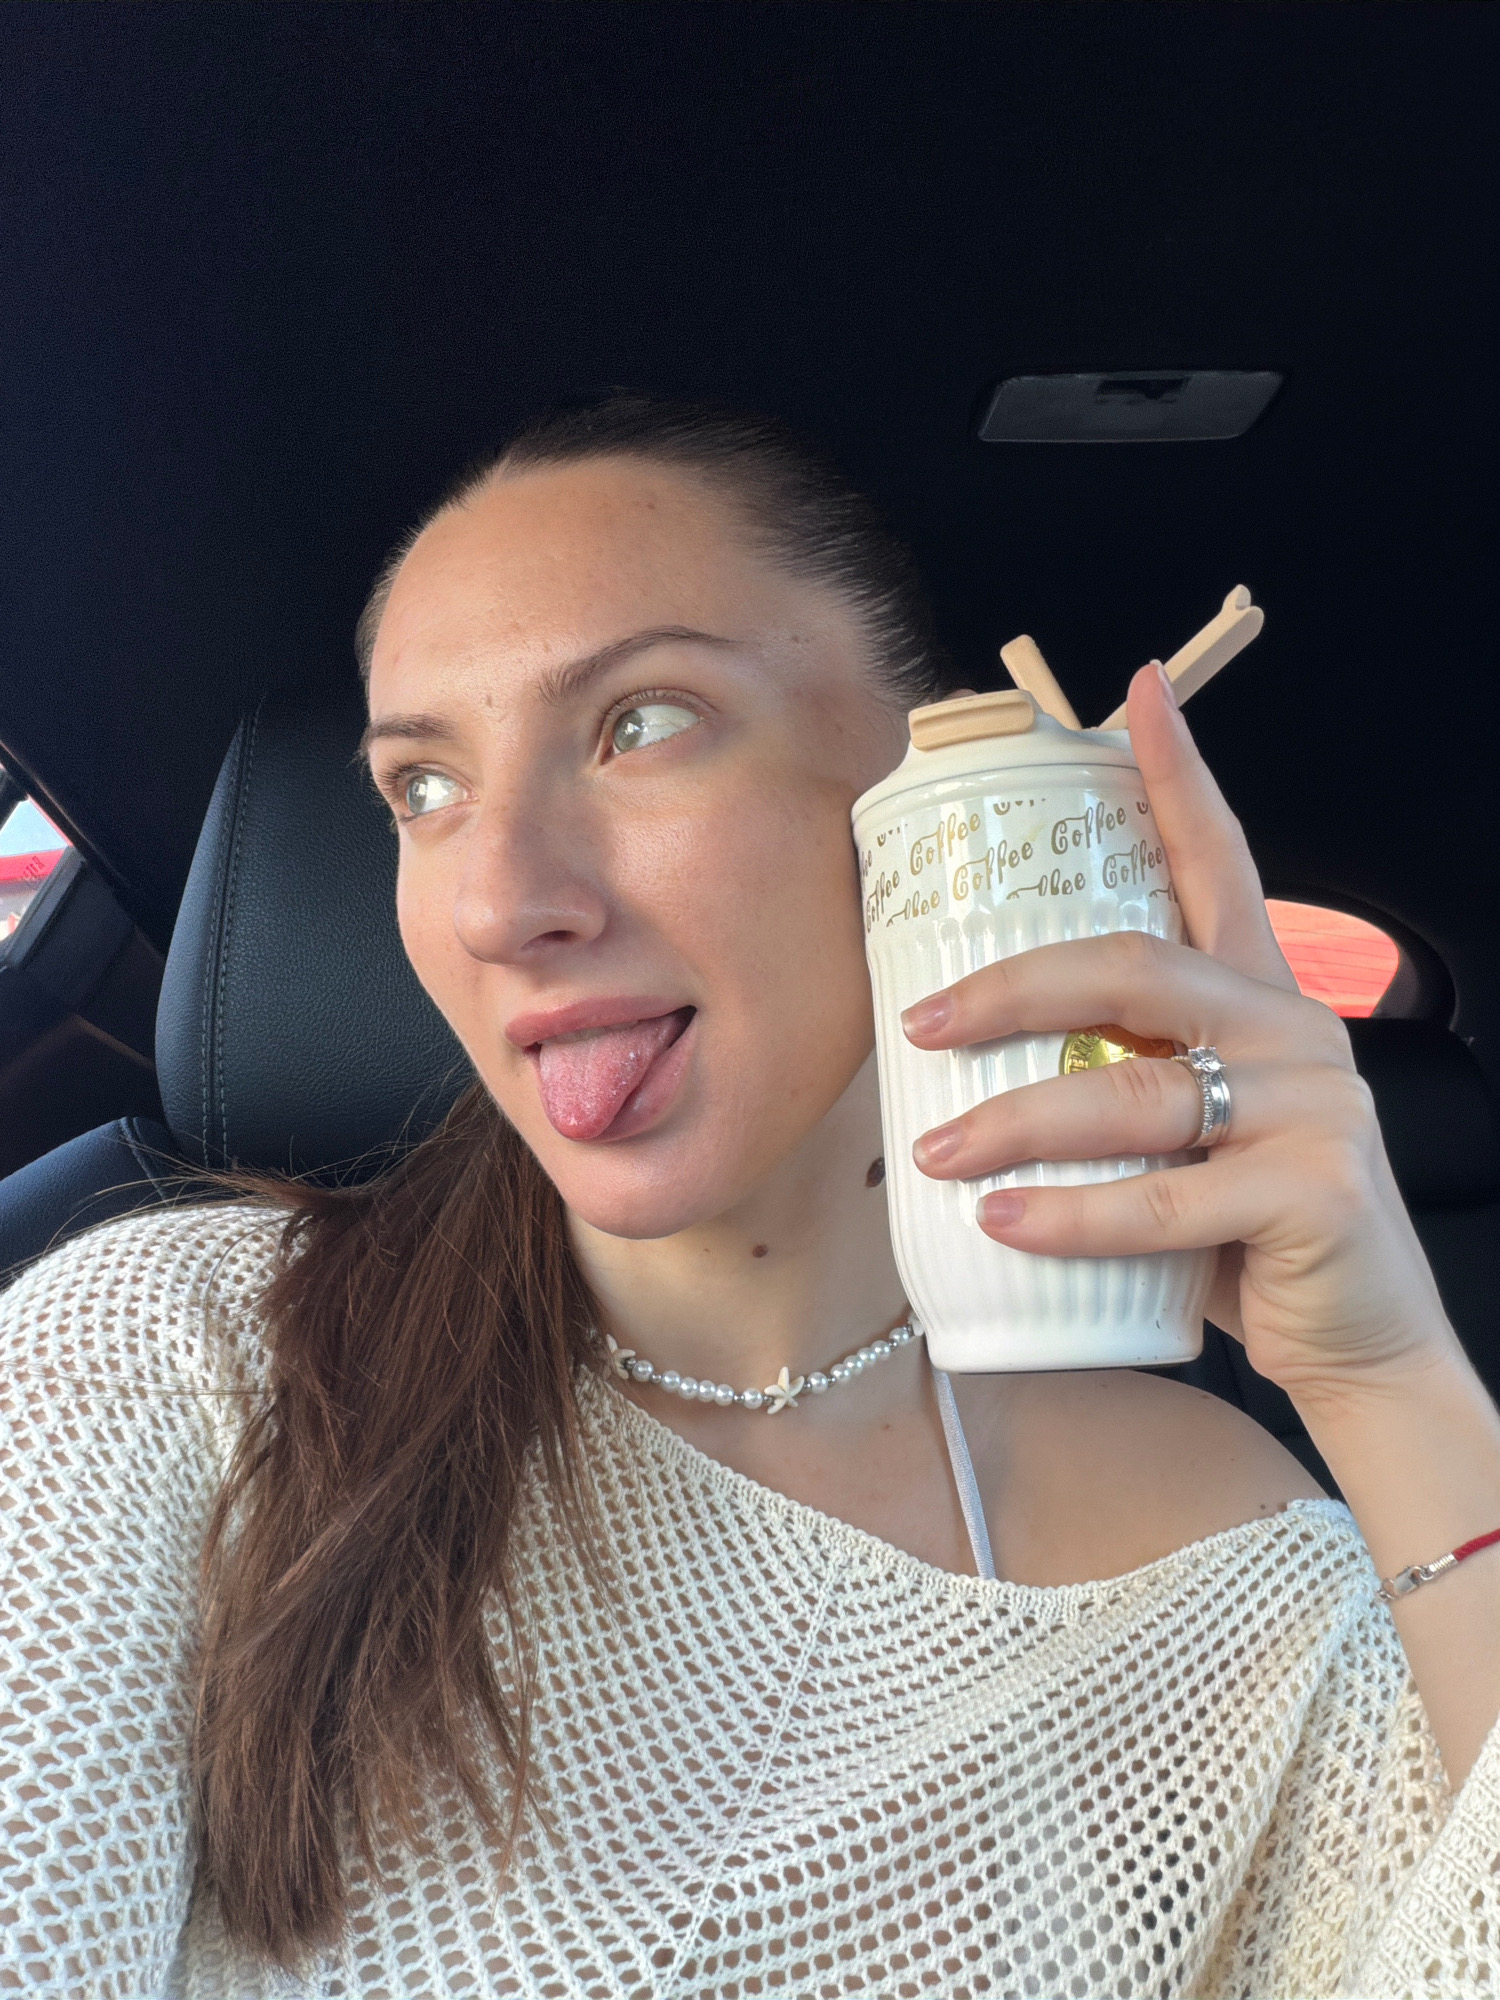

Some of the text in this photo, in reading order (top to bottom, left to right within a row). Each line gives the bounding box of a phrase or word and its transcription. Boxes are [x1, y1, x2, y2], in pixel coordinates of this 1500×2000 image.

[910, 812, 981, 876] Coffee
[1051, 801, 1126, 855] Coffee
[952, 840, 1034, 902] Coffee
[1102, 839, 1163, 889] Coffee
[866, 869, 900, 933] Coffee
